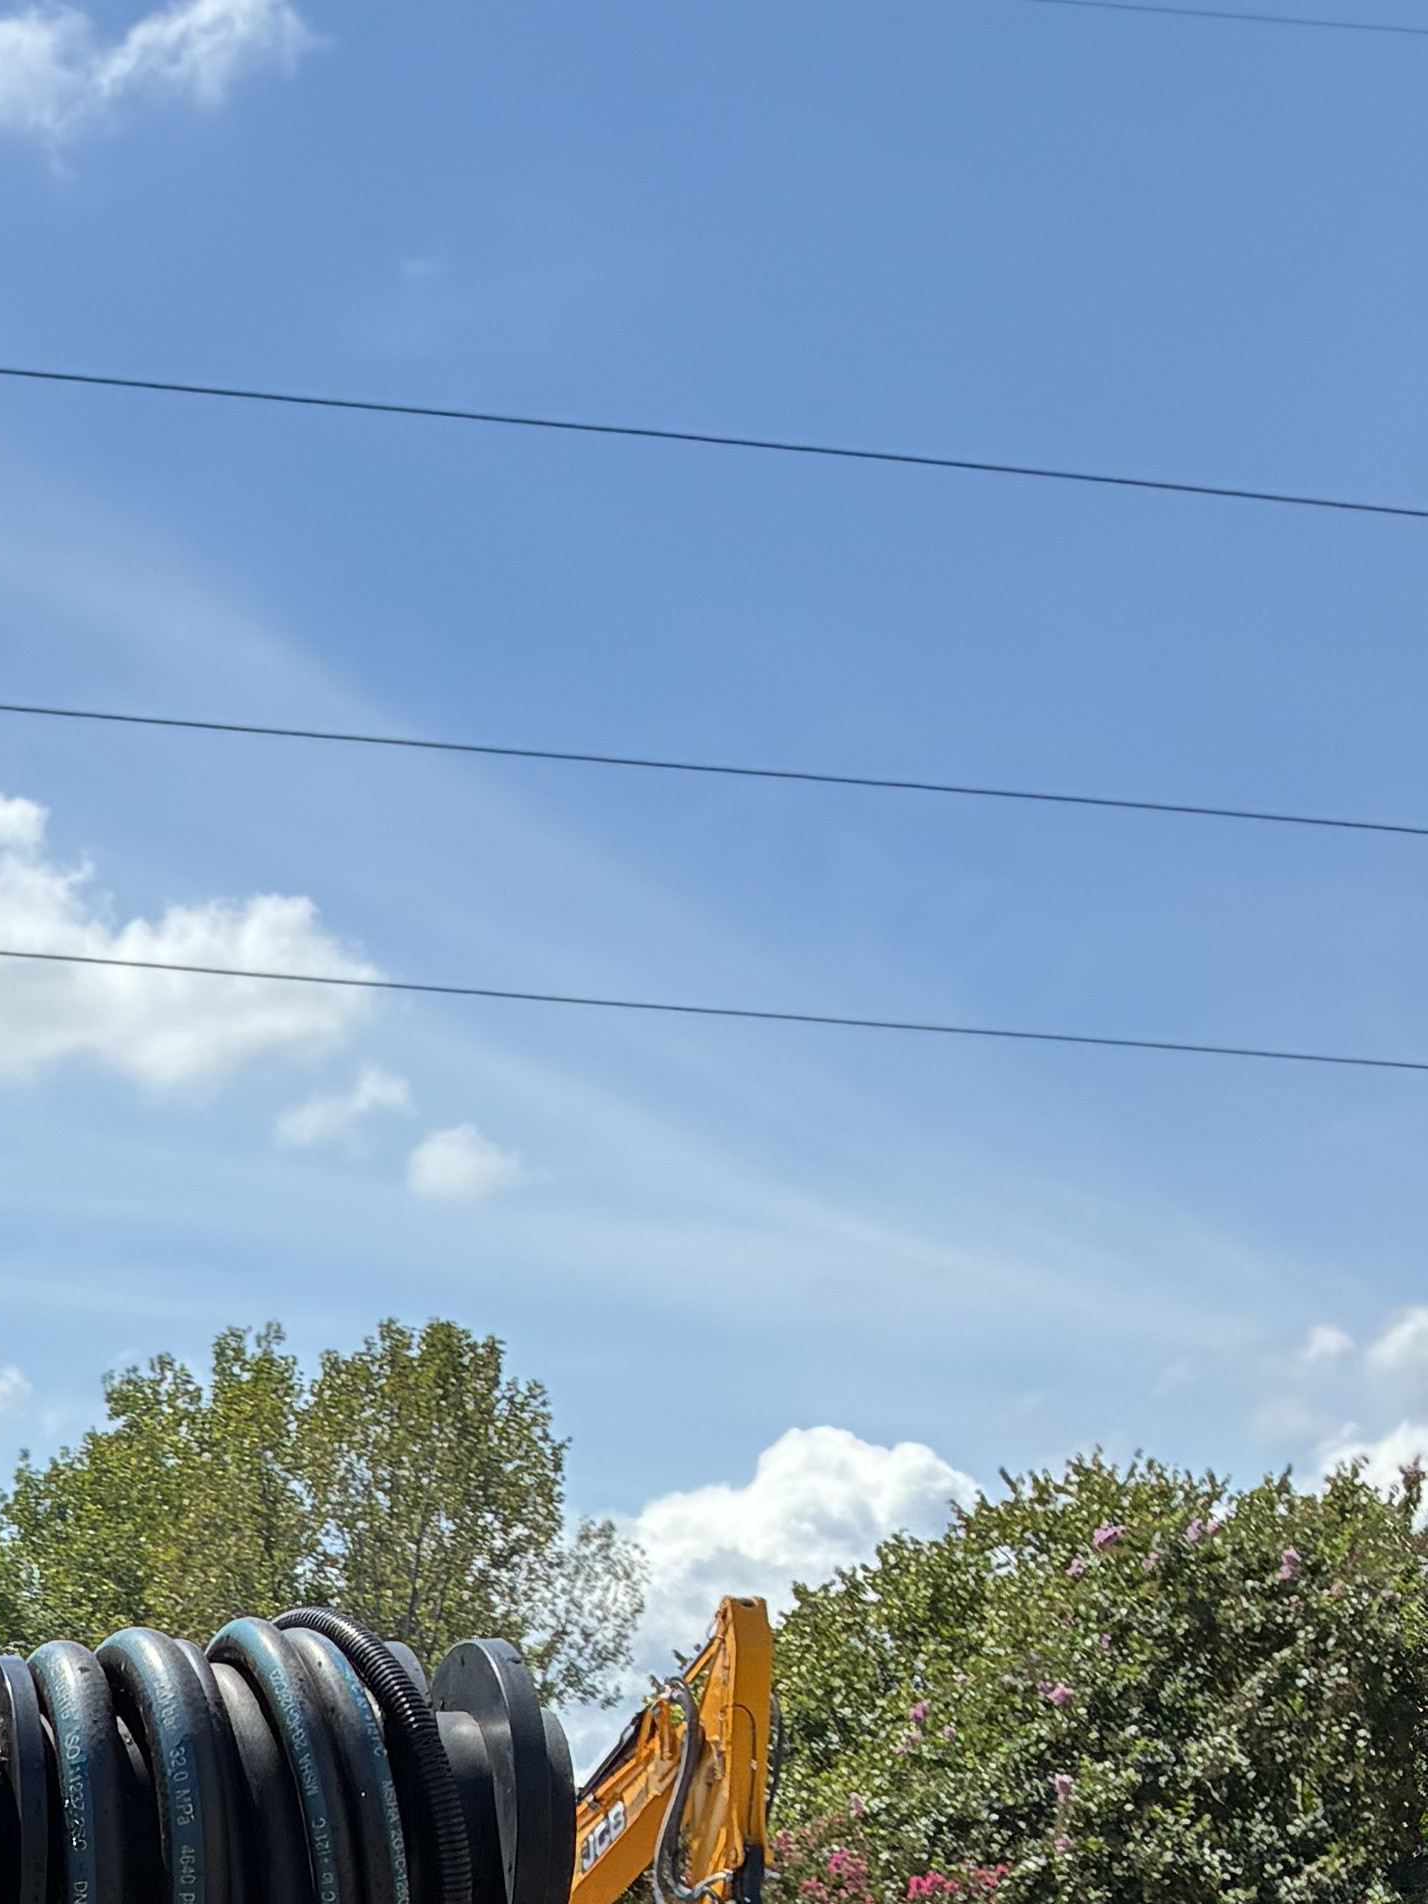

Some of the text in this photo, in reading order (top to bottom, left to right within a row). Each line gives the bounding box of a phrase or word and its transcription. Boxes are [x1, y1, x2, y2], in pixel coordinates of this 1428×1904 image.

[296, 1754, 321, 1796] MSHA
[174, 1788, 196, 1827] MPa
[378, 1779, 399, 1823] MSHA
[583, 1800, 625, 1871] JCB
[178, 1844, 197, 1885] 4640
